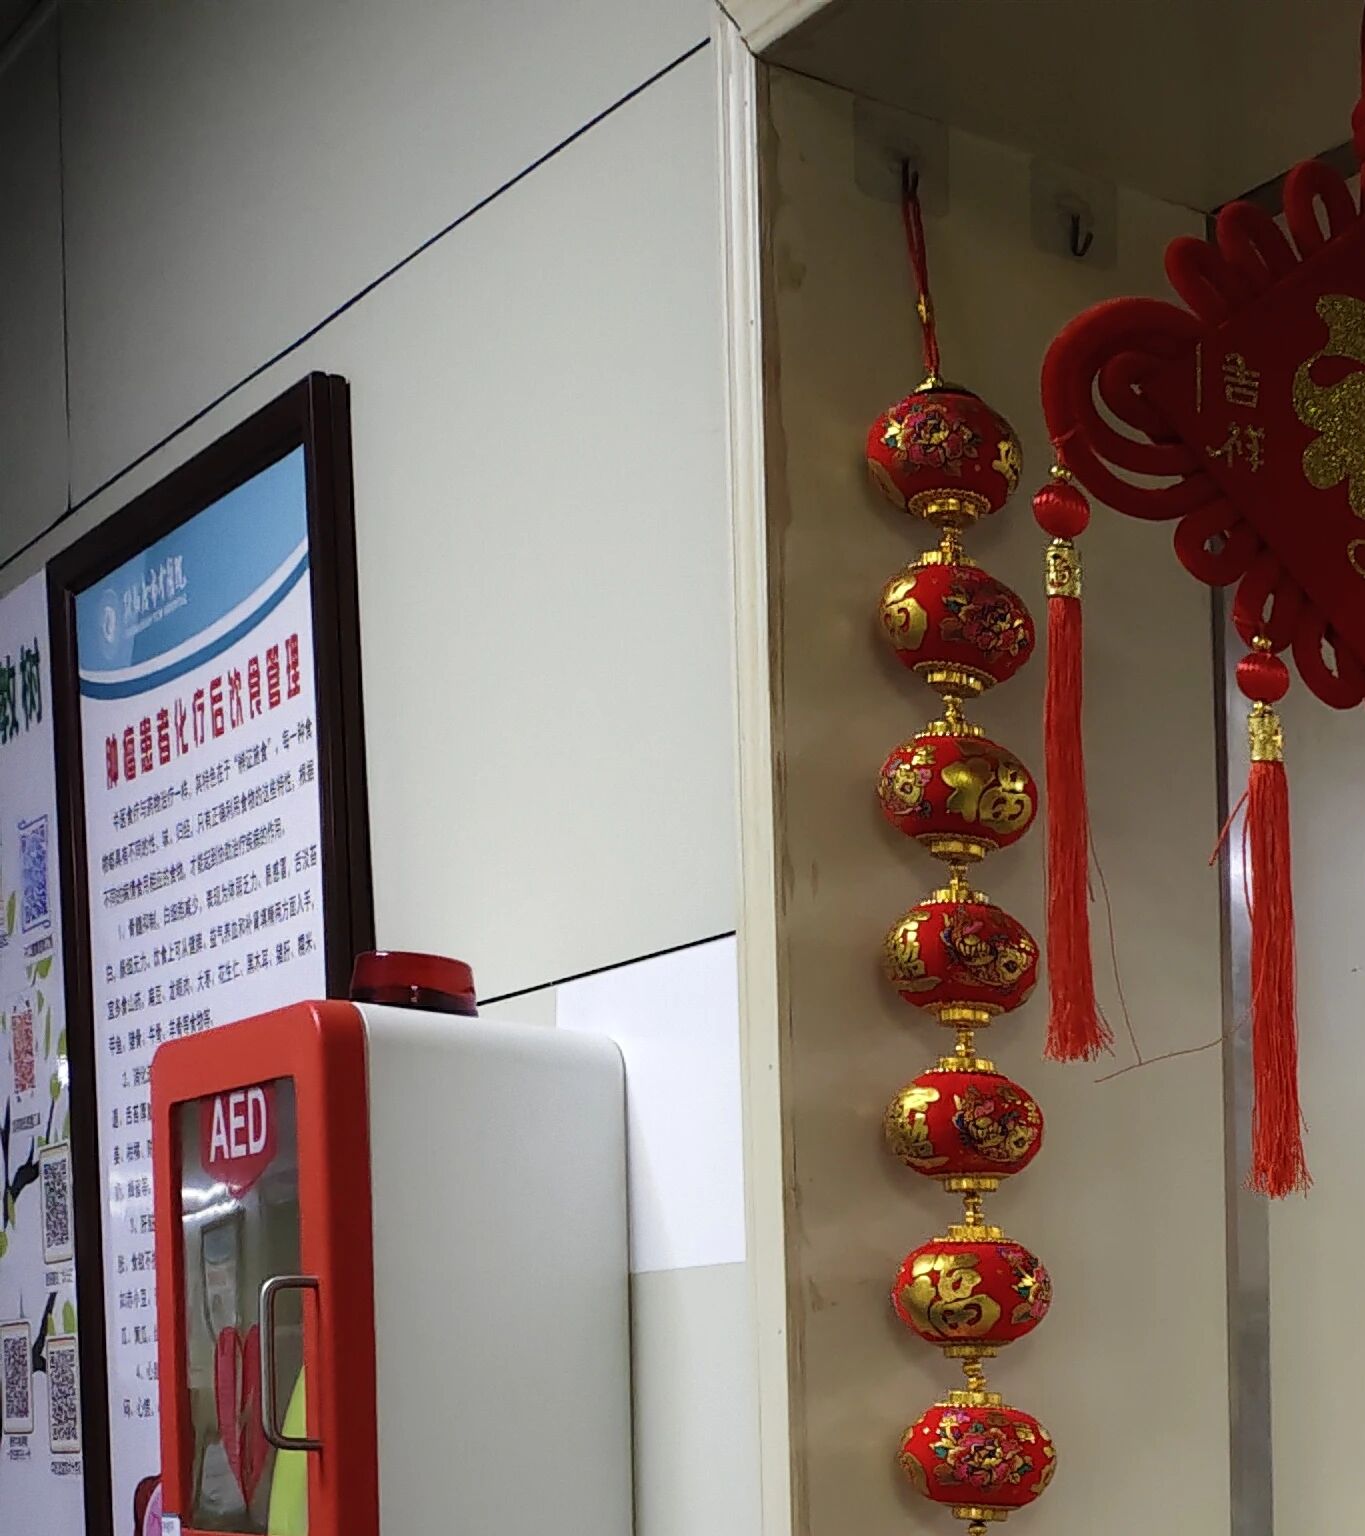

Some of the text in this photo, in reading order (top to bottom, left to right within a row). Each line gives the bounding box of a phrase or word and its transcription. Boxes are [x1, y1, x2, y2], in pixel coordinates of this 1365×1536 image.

[106, 633, 301, 789] 肿瘤患者化疗后饮食管理
[209, 1087, 268, 1163] AED
